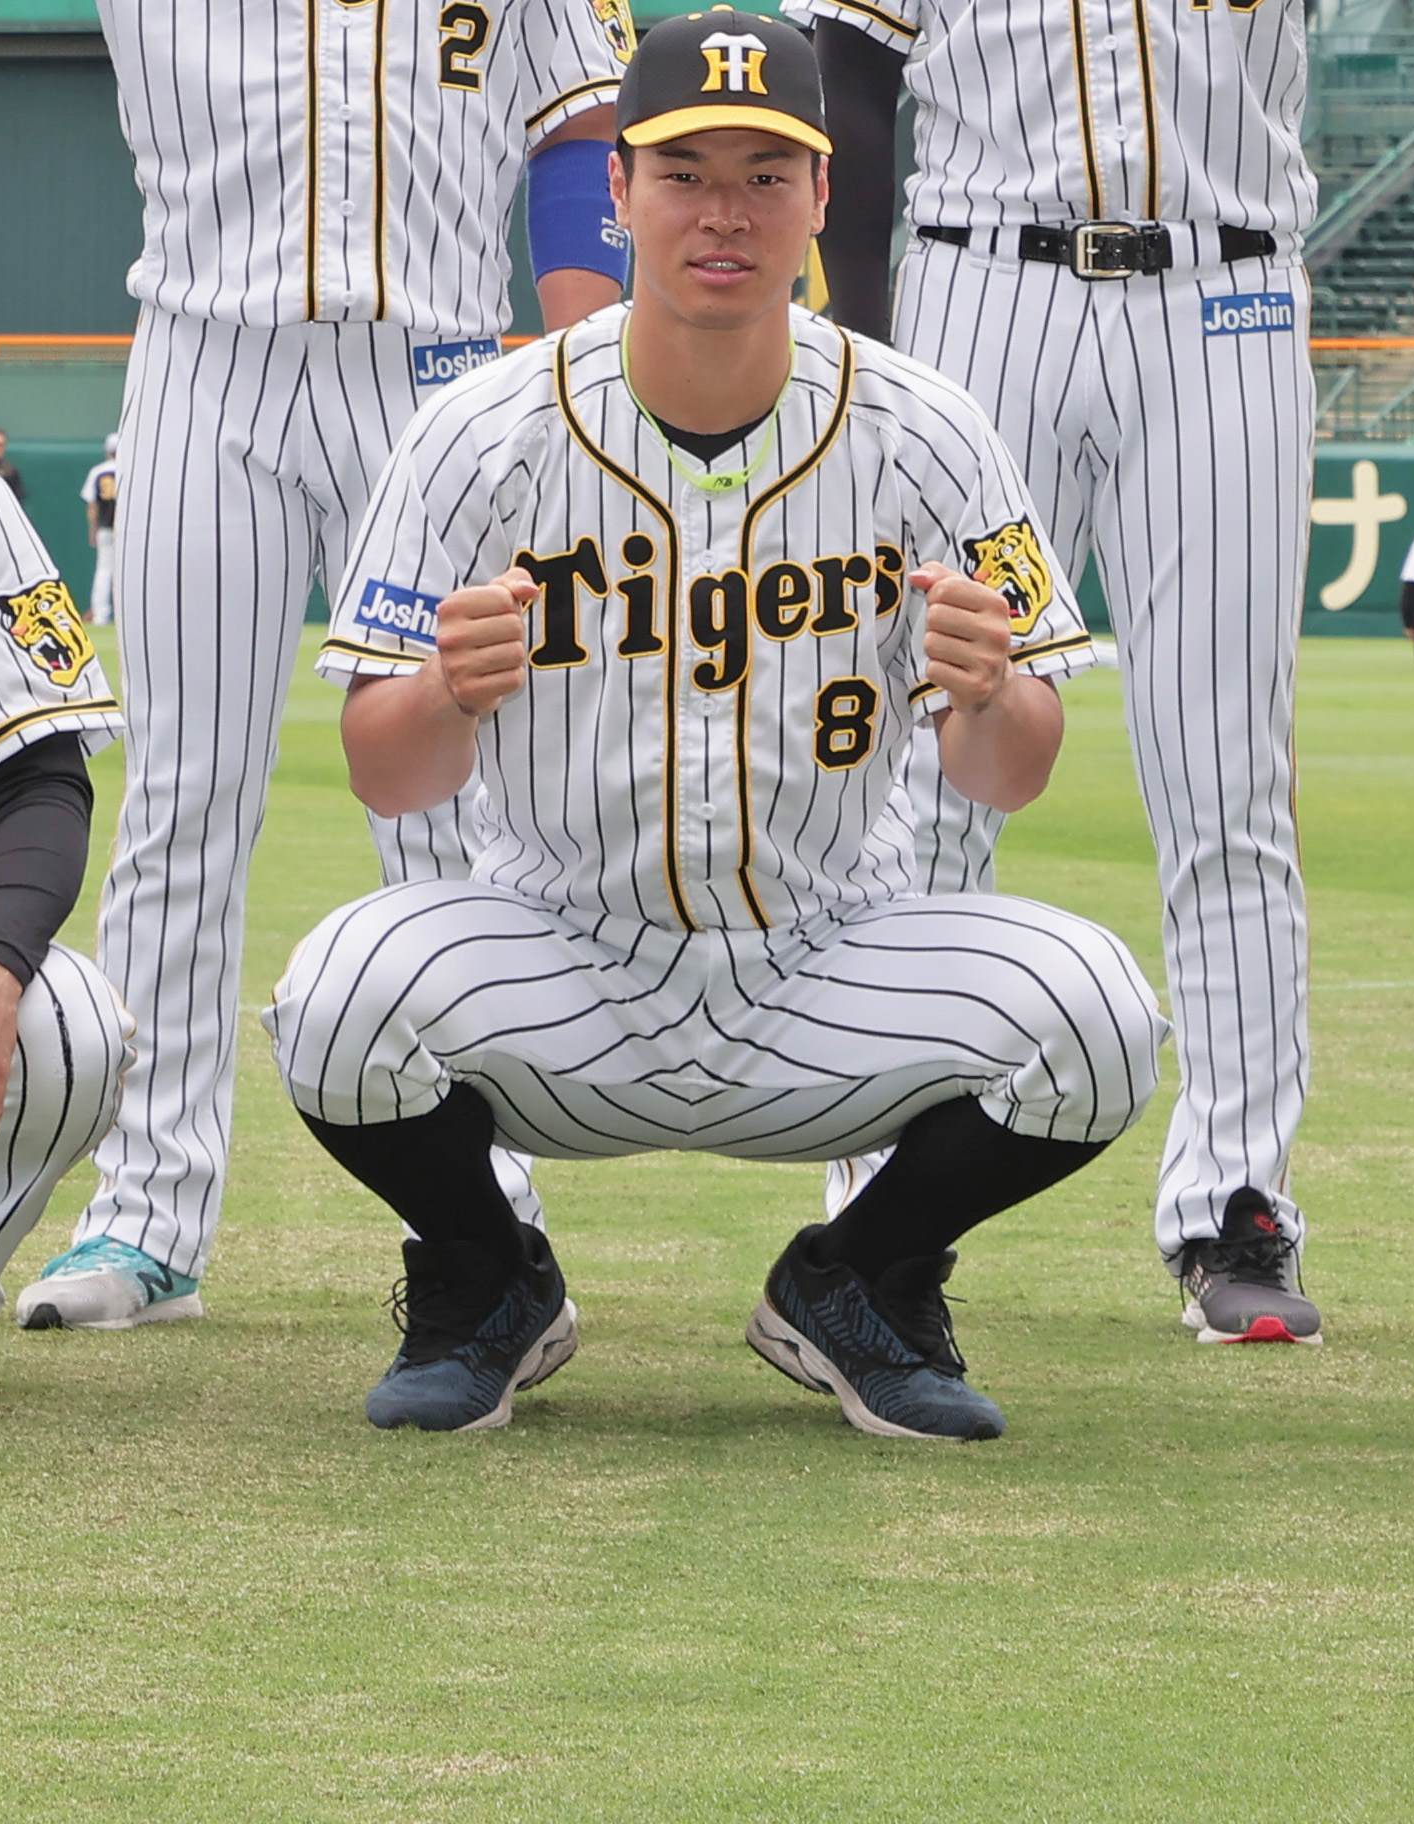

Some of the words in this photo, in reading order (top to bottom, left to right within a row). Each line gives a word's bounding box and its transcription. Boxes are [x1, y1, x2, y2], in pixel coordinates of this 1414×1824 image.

[436, 0, 492, 92] 2
[1204, 297, 1292, 331] Joshin
[512, 531, 907, 692] Tigers
[814, 675, 878, 772] 8
